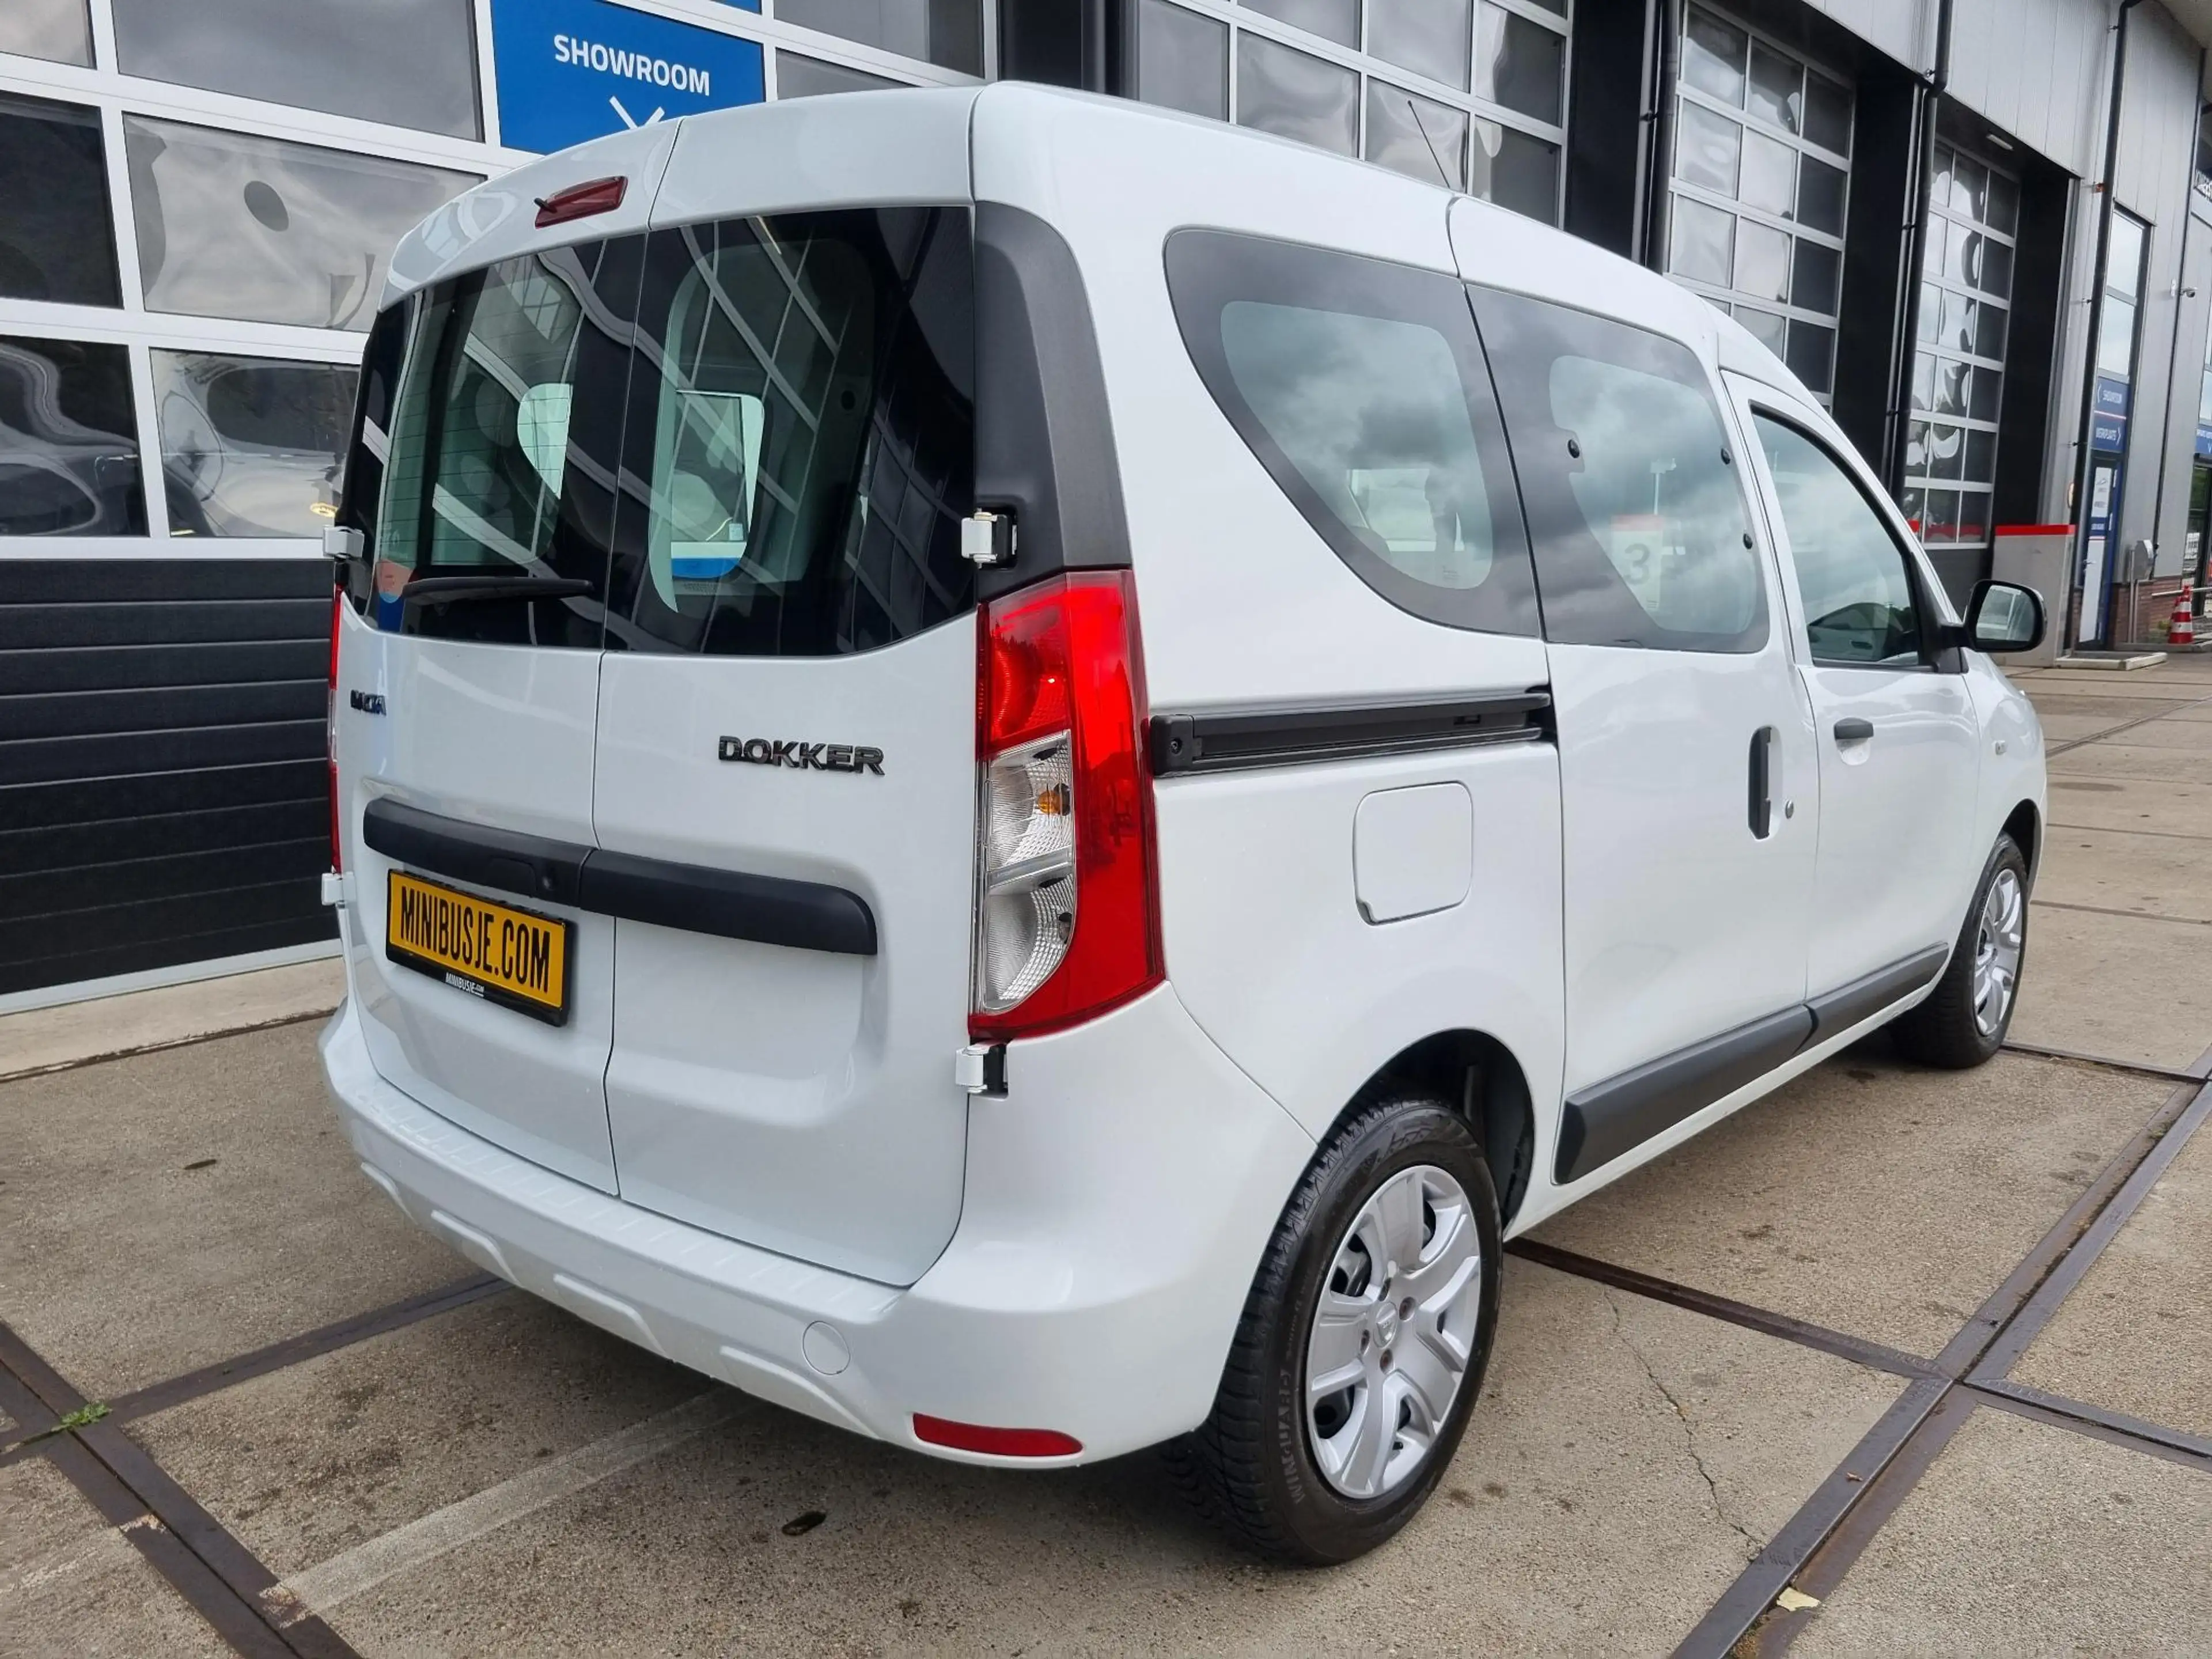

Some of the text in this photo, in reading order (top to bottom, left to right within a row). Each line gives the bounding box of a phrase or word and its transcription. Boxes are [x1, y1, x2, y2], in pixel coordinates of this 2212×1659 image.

[553, 33, 710, 96] SHOWROOM
[718, 735, 885, 776] DOKKER
[400, 885, 551, 994] MINIBUSJE.COM
